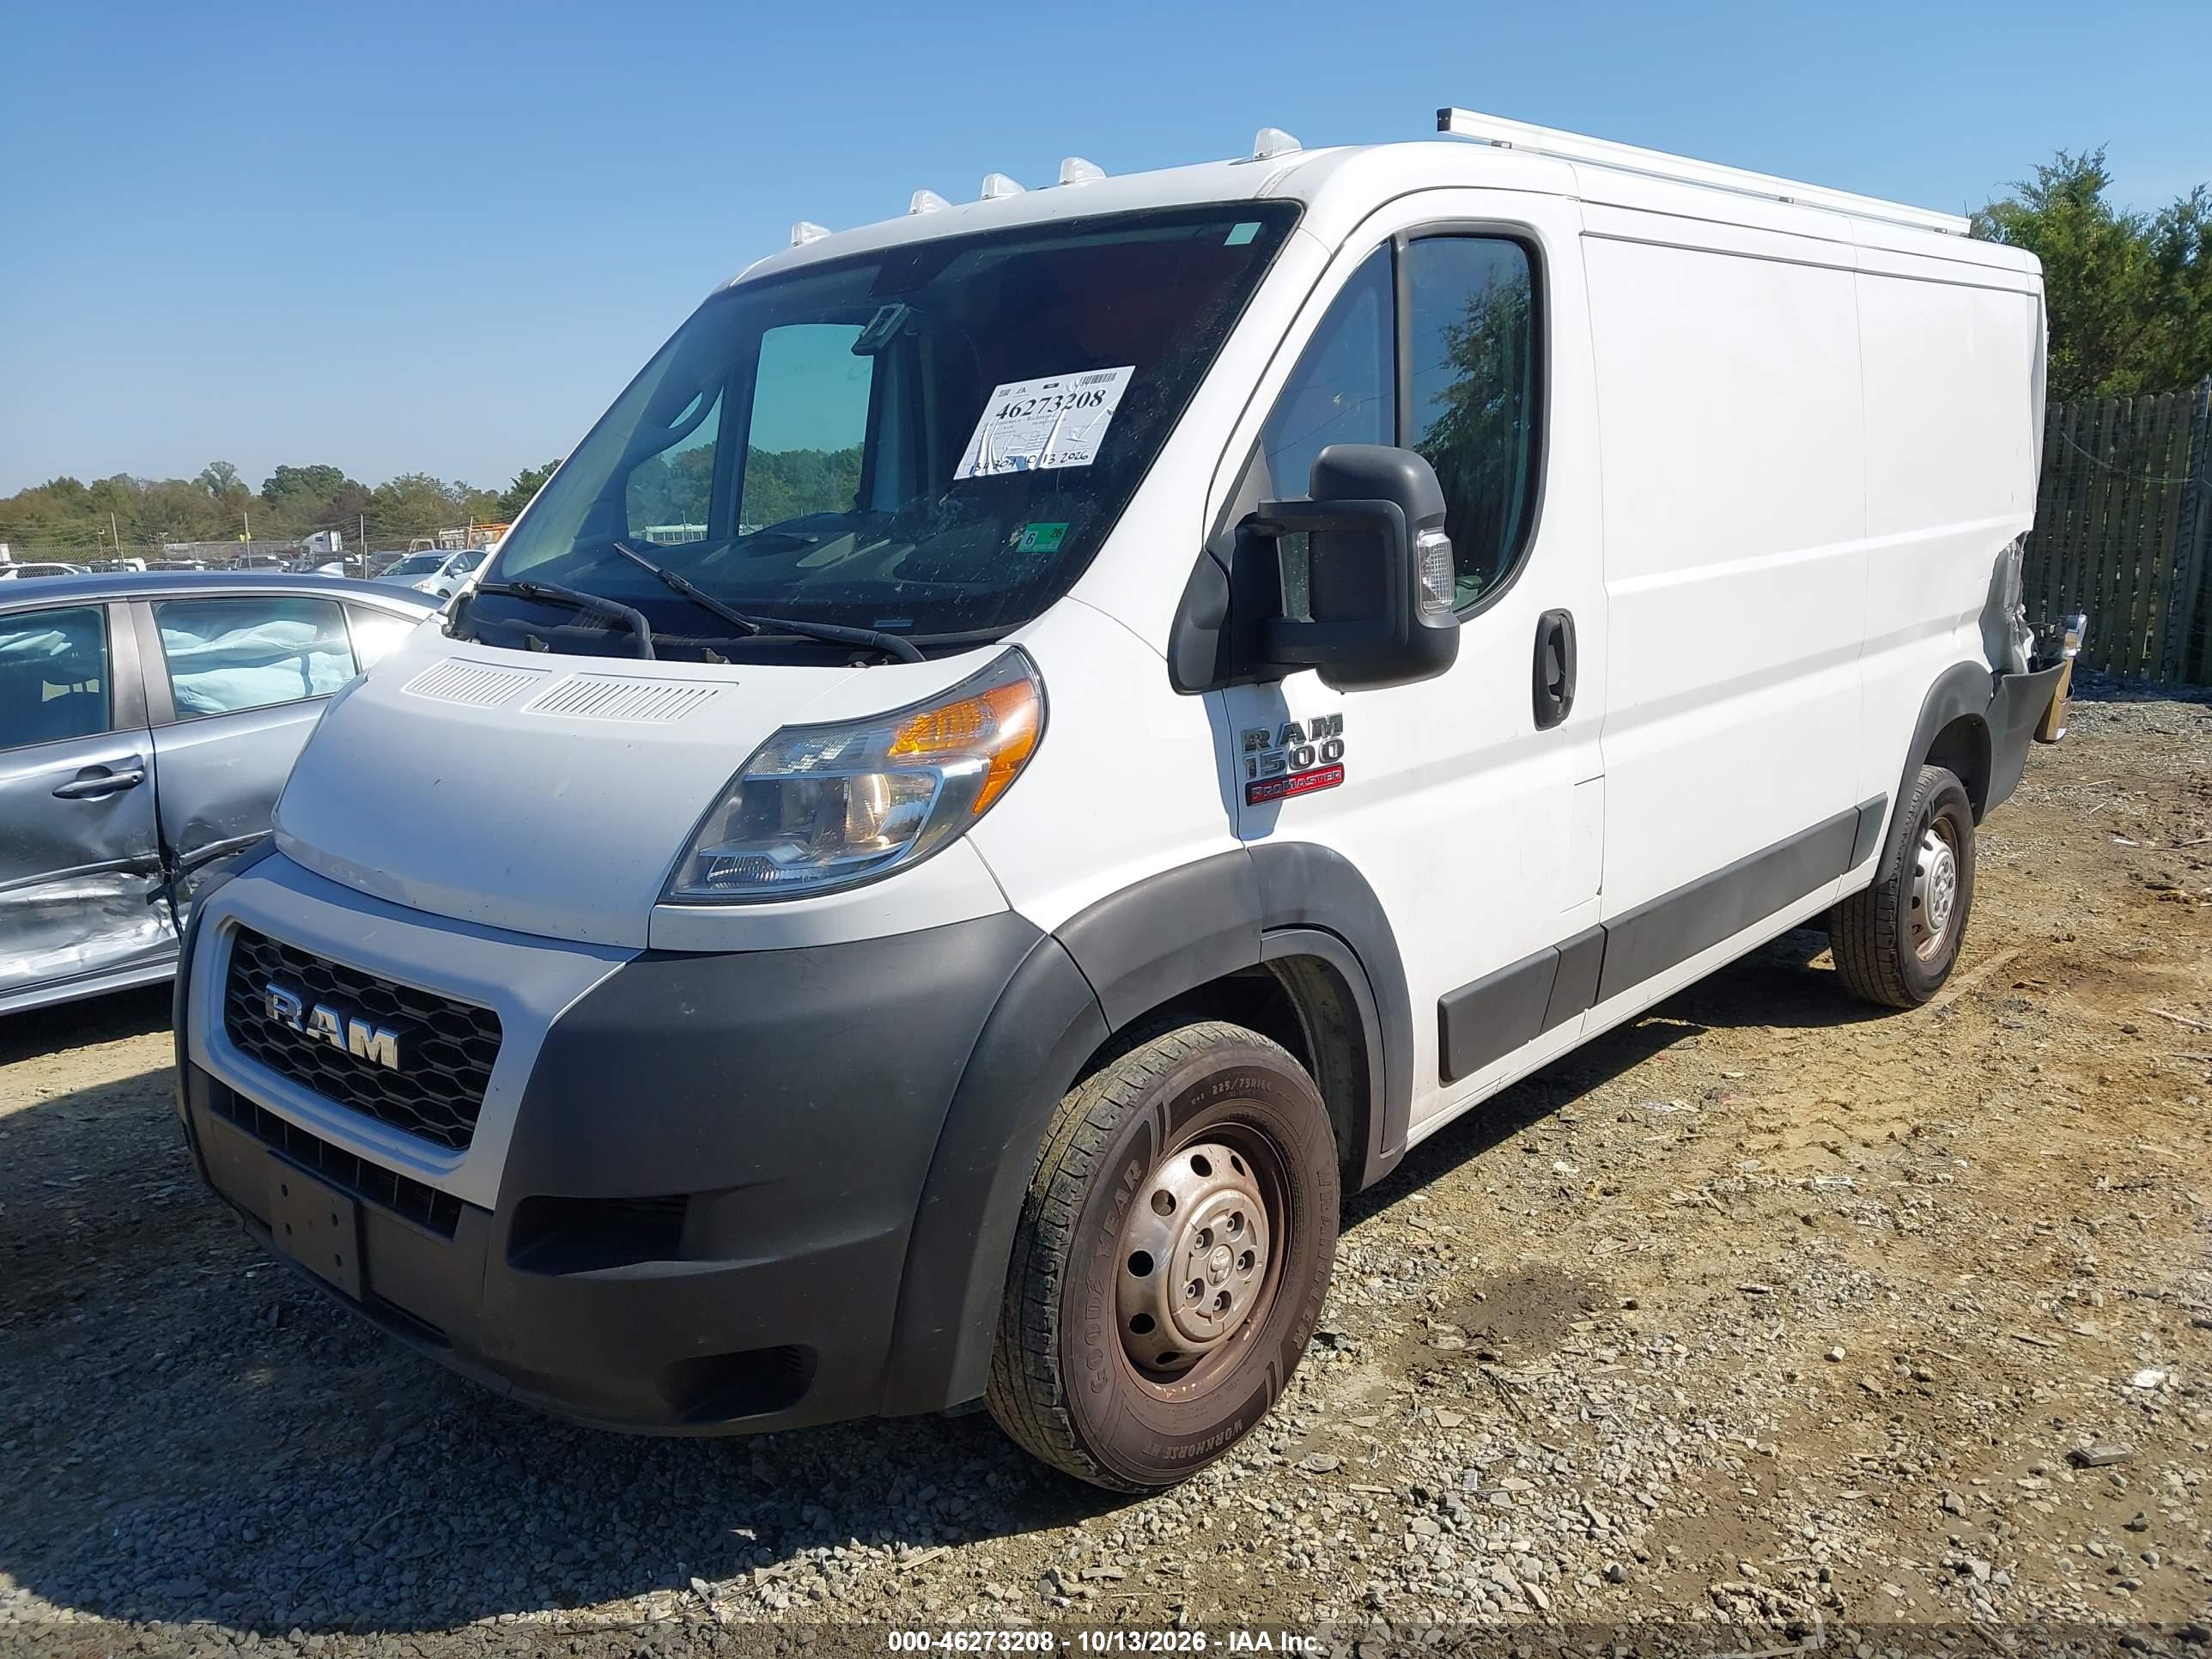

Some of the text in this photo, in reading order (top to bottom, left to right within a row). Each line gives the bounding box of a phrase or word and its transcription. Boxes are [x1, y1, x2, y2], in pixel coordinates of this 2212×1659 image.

[995, 389, 1107, 420] 46273208
[1042, 453, 1055, 465] 13
[1060, 451, 1090, 463] 2026
[1025, 532, 1036, 545] 6
[1241, 712, 1344, 754] RAM
[1243, 738, 1345, 780] 1500
[264, 981, 398, 1071] RAM
[1164, 1419, 1244, 1460] WORKHORSE
